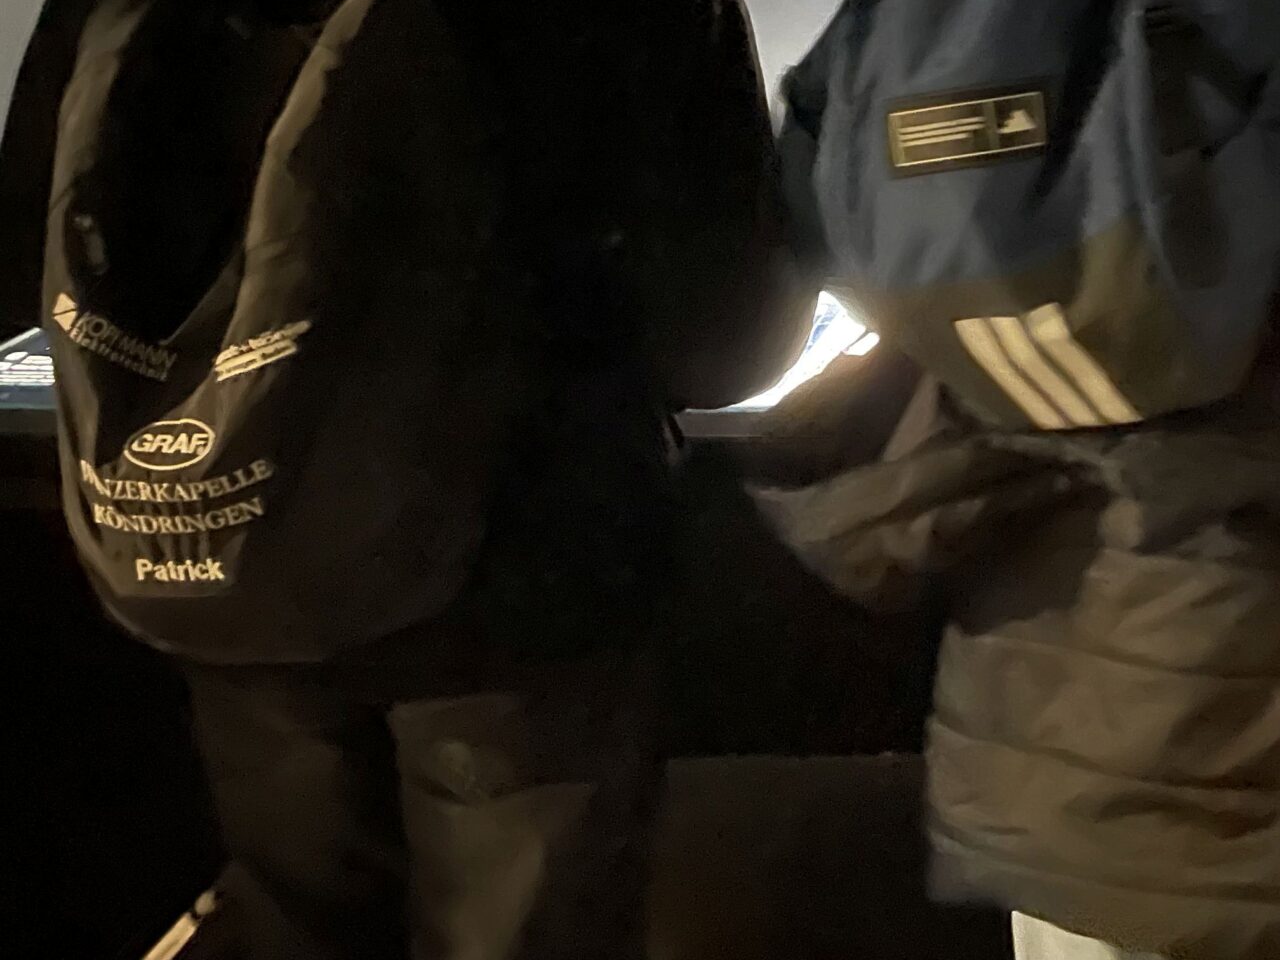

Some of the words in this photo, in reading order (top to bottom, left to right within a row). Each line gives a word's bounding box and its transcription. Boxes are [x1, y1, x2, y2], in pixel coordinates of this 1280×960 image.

[131, 432, 209, 455] GRAF
[94, 496, 266, 535] KÖNDRINGEN
[135, 558, 226, 582] Patrick
